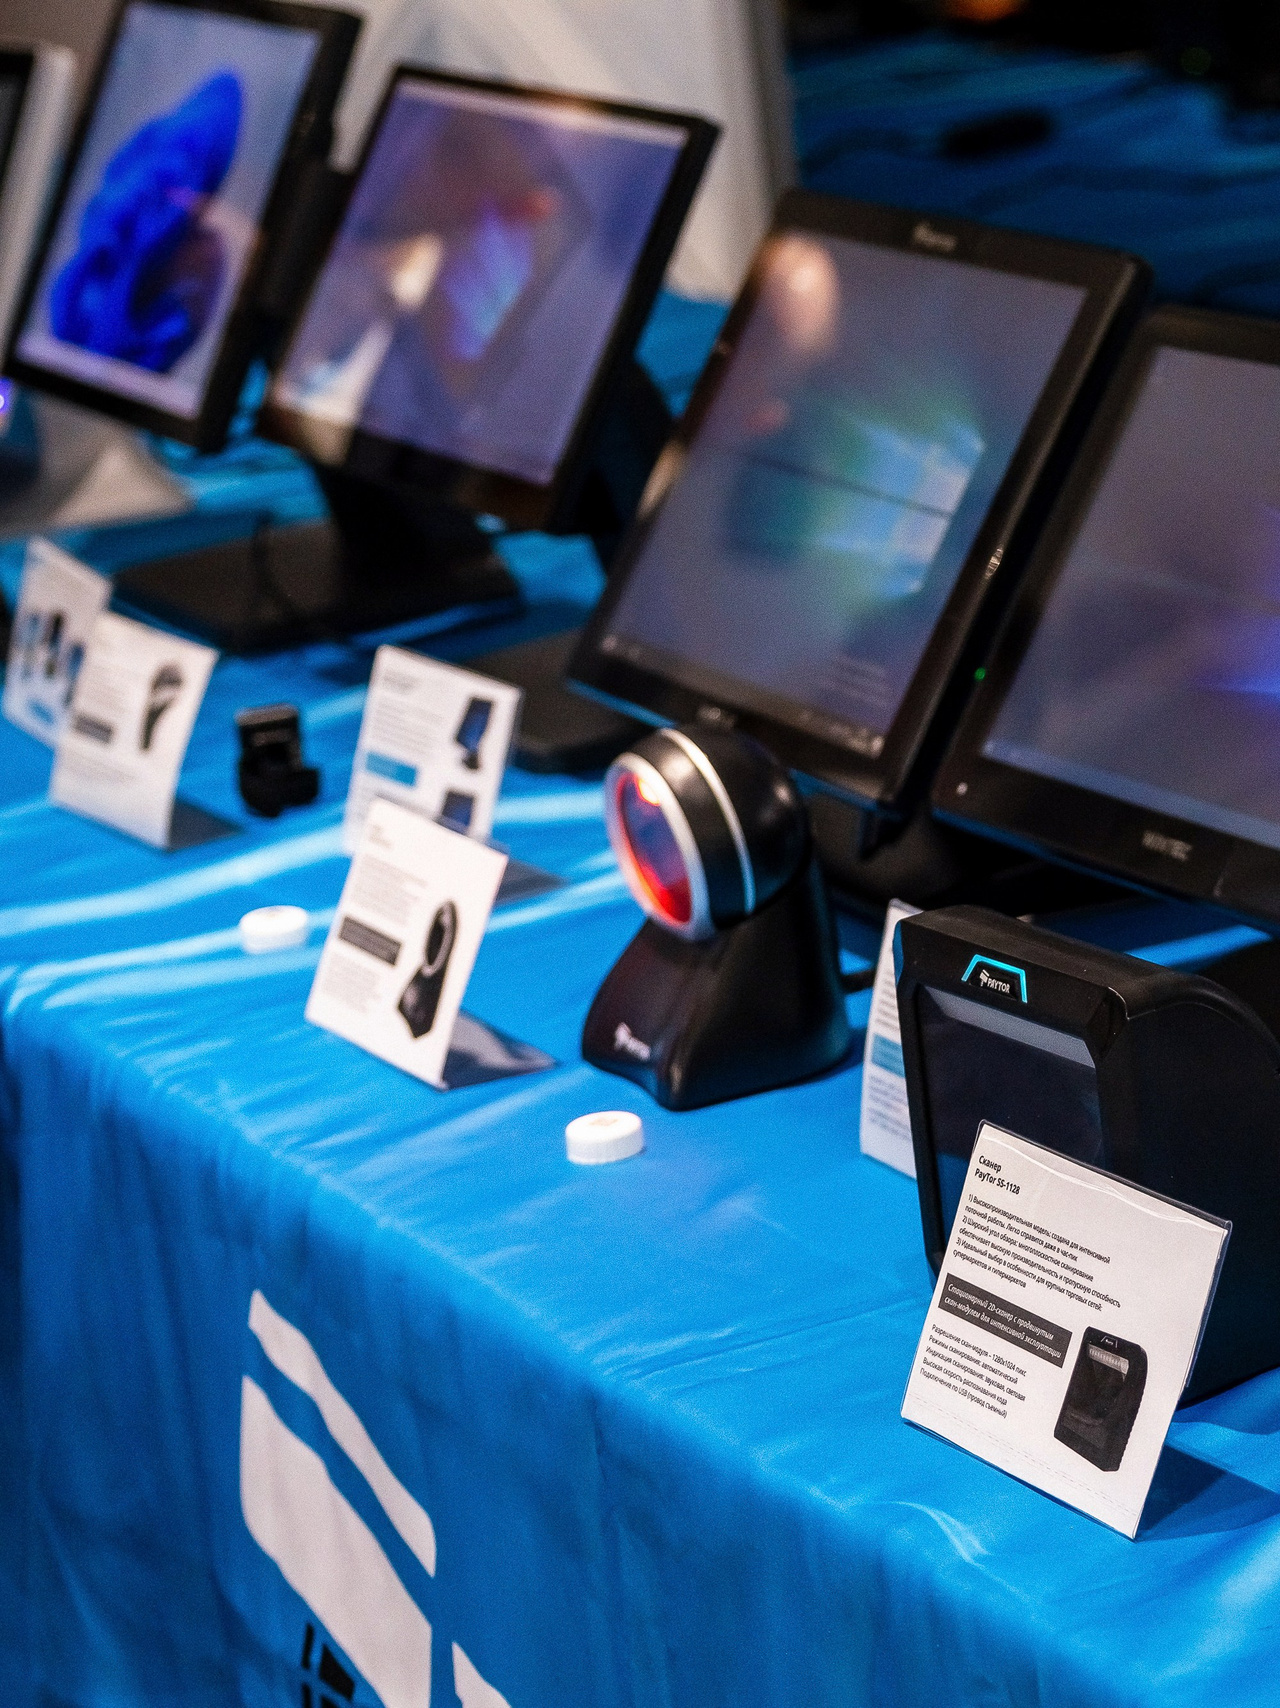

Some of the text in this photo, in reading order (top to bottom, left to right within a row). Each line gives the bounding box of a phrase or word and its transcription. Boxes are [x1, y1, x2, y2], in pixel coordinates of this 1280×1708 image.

[987, 978, 1010, 993] PAYTOR
[974, 1168, 1020, 1195] PayTor SS-1128
[979, 1155, 1002, 1174] Сканер
[965, 1205, 988, 1220] поточной
[987, 1216, 1005, 1229] работы.
[1005, 1223, 1020, 1235] Легко
[1020, 1231, 1044, 1246] справится
[1043, 1242, 1056, 1252] даже
[1060, 1249, 1078, 1262] час-пик
[967, 1218, 989, 1233] Широкий
[988, 1229, 1000, 1238] угол
[1000, 1233, 1018, 1247] обзора:
[1018, 1242, 1061, 1267] многоплоскостное
[1060, 1262, 1094, 1282] сканирование
[973, 1196, 1033, 1228] Высокопроизводительная
[1051, 1233, 1070, 1246] создана
[1069, 1241, 1079, 1249] для
[1078, 1246, 1110, 1264] интенсивной
[953, 1249, 988, 1270] супермаркетов
[991, 1267, 1027, 1288] гипермаркетов
[959, 1227, 991, 1246] обеспечивает
[990, 1242, 1011, 1256] высокую
[1011, 1252, 1059, 1279] производительность
[1063, 1276, 1092, 1294] пропускную
[1091, 1289, 1121, 1308] способность
[961, 1240, 988, 1257] Идеальный
[987, 1253, 1003, 1265] выбор
[1006, 1262, 1037, 1280] особенности
[1035, 1276, 1045, 1284] для
[1045, 1280, 1066, 1294] крупных
[1066, 1289, 1088, 1304] торговых
[944, 1297, 1062, 1358] скан-модулем для интенсивной эксплуатации
[948, 1283, 989, 1308] Стационарный
[987, 1302, 1014, 1322] 2D-сканер
[1016, 1318, 1054, 1340] продвинутым
[929, 1334, 949, 1350] Режимы
[981, 1362, 1018, 1384] автоматический
[932, 1324, 961, 1344] Разрешение
[960, 1339, 989, 1357] скан-модуля
[920, 1367, 952, 1389] Подключение
[922, 1357, 1008, 1406] Высокая скорость распознавания кода
[925, 1347, 952, 1363] Индикация
[1006, 1387, 1026, 1401] световая
